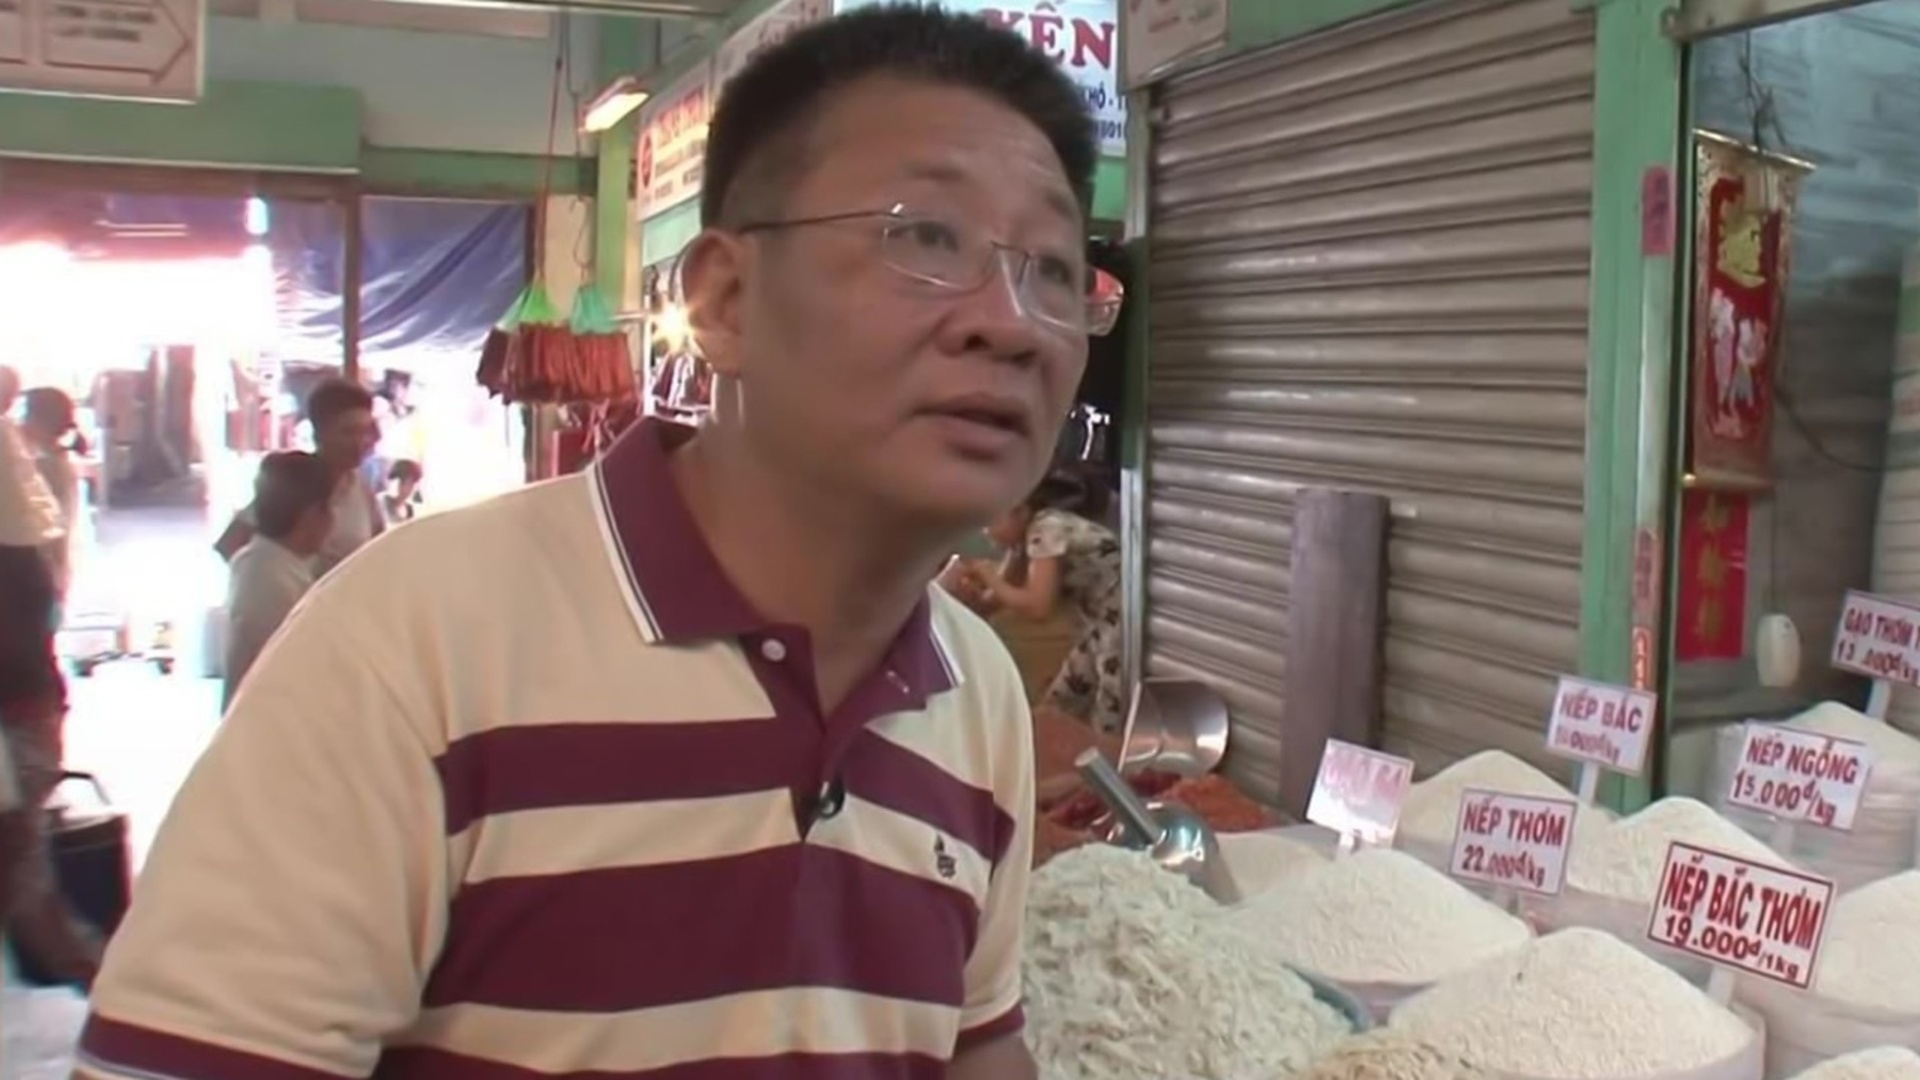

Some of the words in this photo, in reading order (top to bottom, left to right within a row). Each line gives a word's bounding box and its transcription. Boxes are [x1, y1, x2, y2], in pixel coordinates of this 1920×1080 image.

[1746, 732, 1785, 767] NẾP
[1463, 796, 1502, 836] NẾP
[1507, 806, 1566, 848] THƠM
[1663, 854, 1709, 915] NẾP
[1706, 866, 1754, 931] BẮC
[1756, 887, 1822, 952] THƠM
